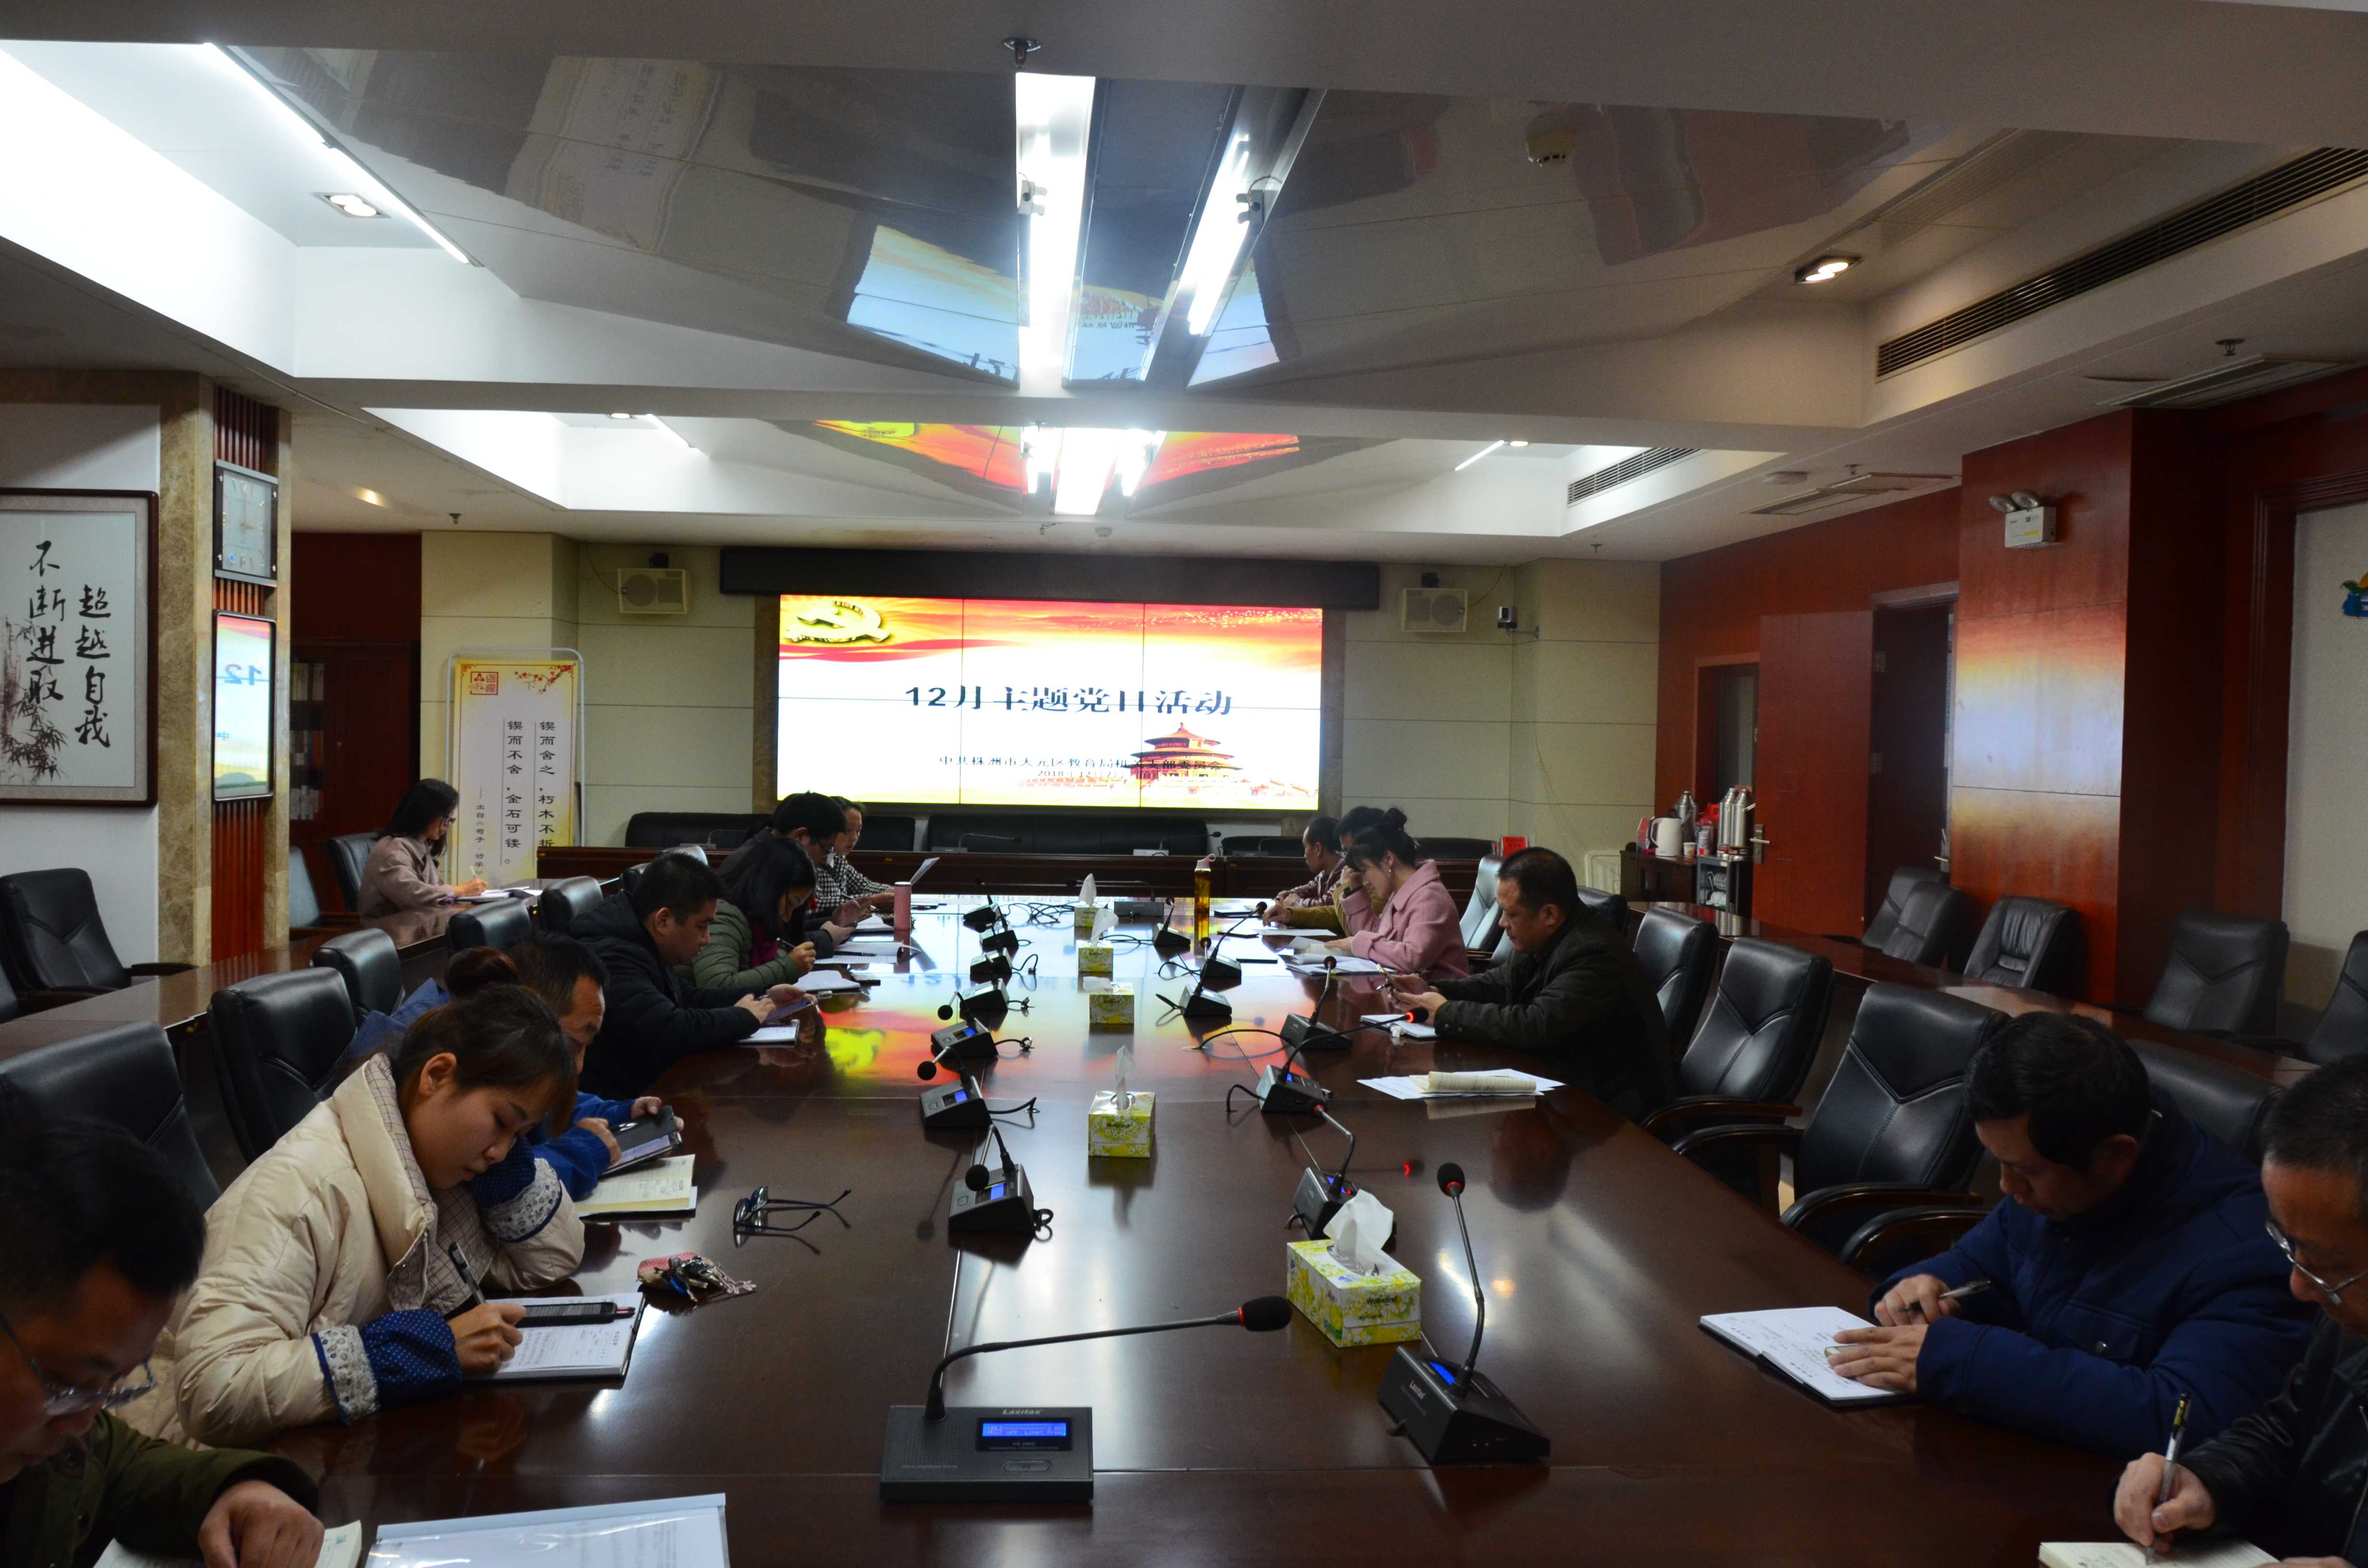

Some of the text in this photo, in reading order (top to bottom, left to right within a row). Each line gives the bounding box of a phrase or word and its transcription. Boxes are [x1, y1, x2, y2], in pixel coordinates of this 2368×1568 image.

[75, 584, 111, 748] 超越自我
[905, 685, 1233, 716] 12月主题党日活动
